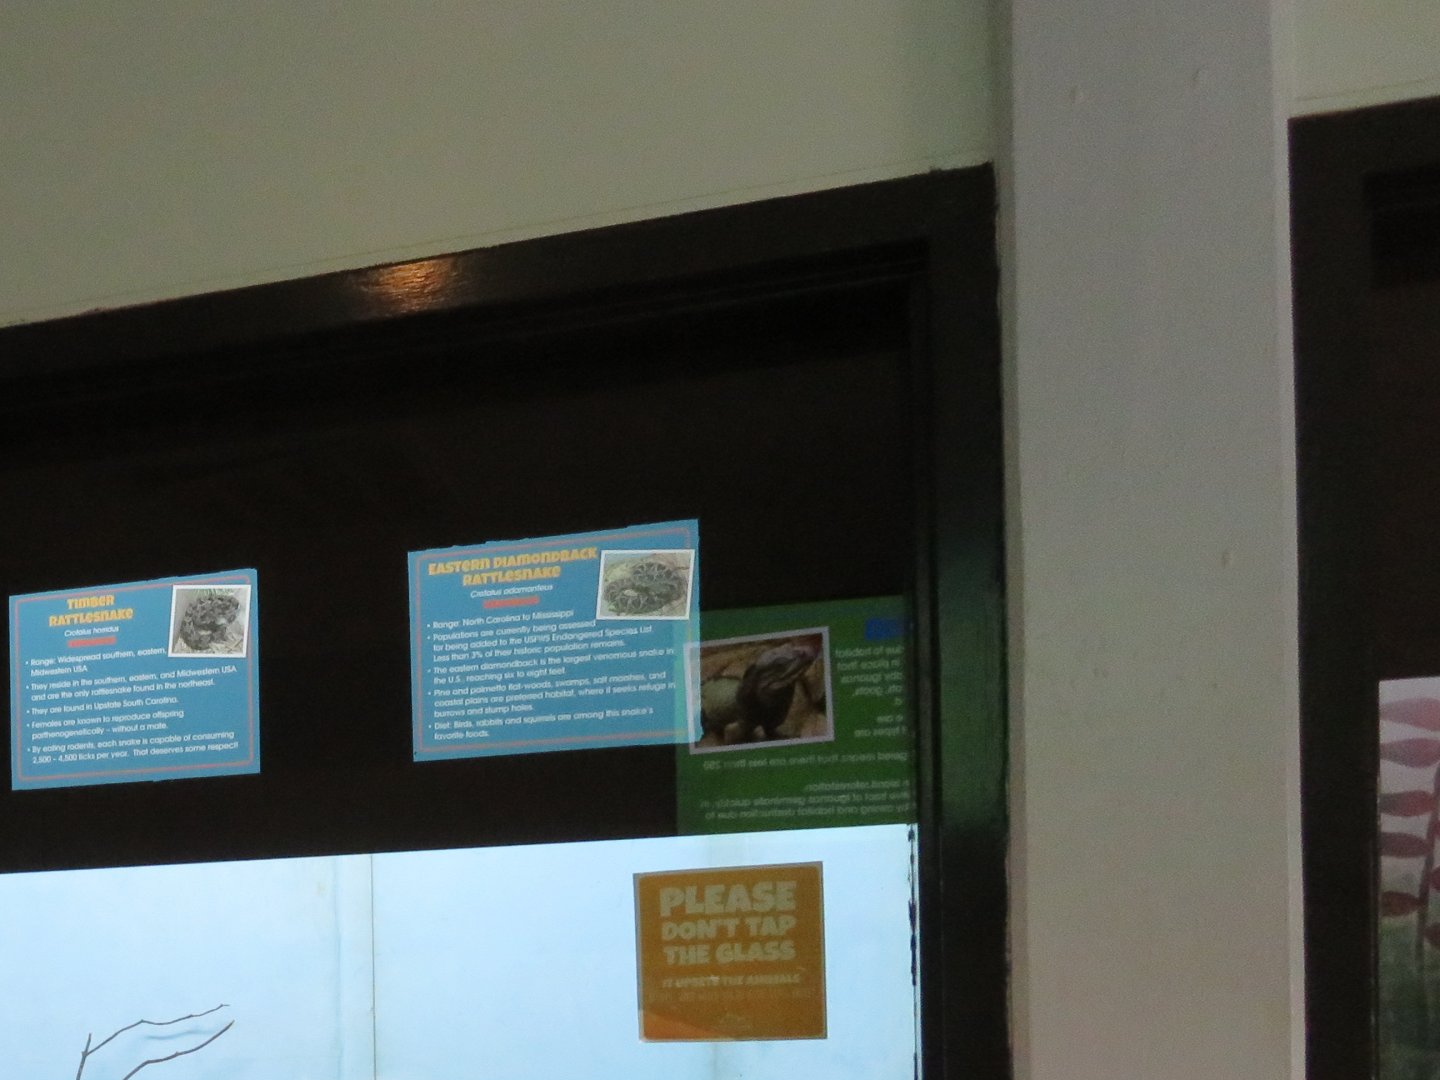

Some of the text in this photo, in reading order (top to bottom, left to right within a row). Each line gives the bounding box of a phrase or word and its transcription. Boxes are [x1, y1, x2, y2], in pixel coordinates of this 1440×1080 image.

[57, 652, 101, 665] Widespread
[31, 666, 72, 677] Midwestern
[49, 680, 71, 689] reside
[177, 667, 220, 678] Midwestern
[91, 686, 132, 696] rattlesnake
[133, 684, 155, 693] found
[63, 704, 85, 713] found
[94, 701, 122, 711] Upstate
[123, 699, 144, 707] South
[32, 720, 62, 729] Females
[77, 716, 102, 726] known
[112, 712, 151, 724] reproduce
[152, 709, 184, 721] offspring
[112, 725, 138, 733] without
[42, 744, 66, 754] eating
[97, 740, 117, 749] each
[118, 738, 141, 747] snake
[149, 735, 182, 746] capable
[192, 731, 235, 743] consuming
[150, 746, 184, 756] deserves
[659, 880, 797, 917] PLEASE
[662, 916, 797, 941] DON'T TAP
[664, 941, 796, 966] THE GLASS
